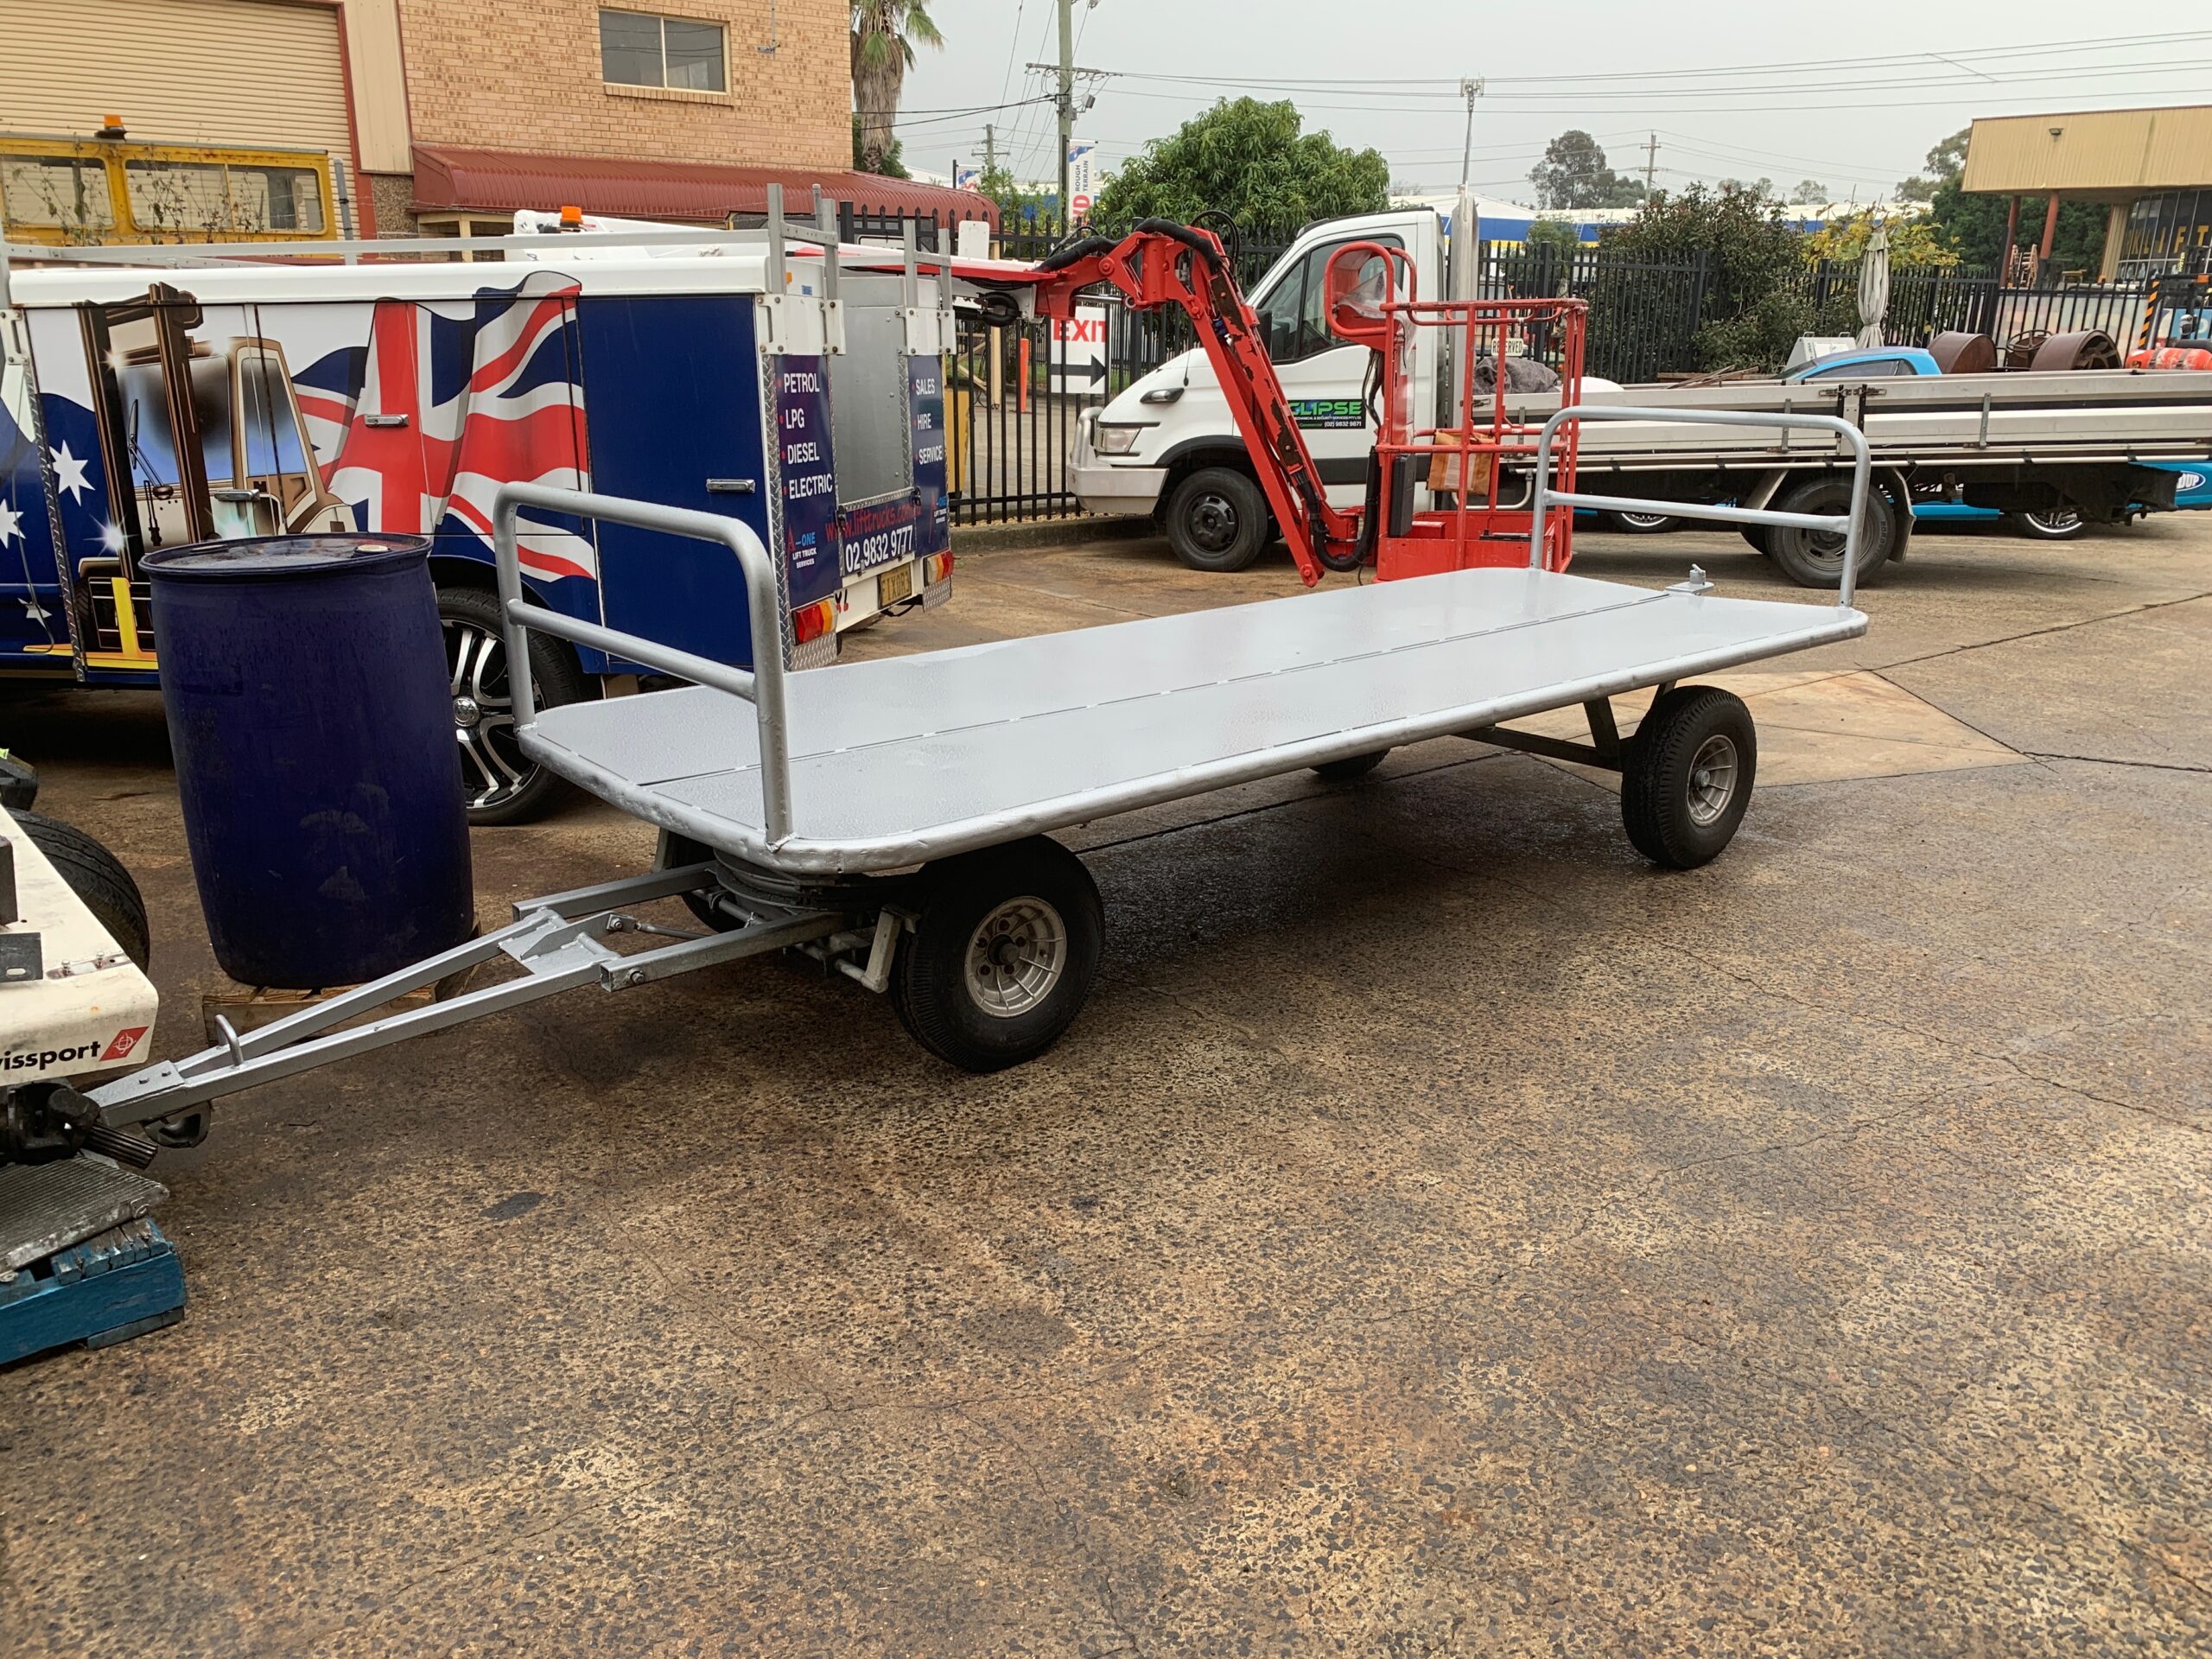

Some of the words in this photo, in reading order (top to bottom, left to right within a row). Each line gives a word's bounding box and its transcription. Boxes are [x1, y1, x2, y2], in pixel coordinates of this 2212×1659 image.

[1053, 319, 1106, 343] EXIT
[1492, 340, 1522, 353] REERVED
[784, 372, 820, 394] PETROL
[916, 378, 936, 396] SALES
[785, 408, 805, 429] LPG
[1288, 401, 1363, 415] CLIPSE
[917, 412, 932, 430] HIRE
[787, 442, 820, 465] DIESEL
[918, 445, 943, 466] SERVICE
[789, 473, 833, 500] ELECTRIC
[792, 550, 802, 561] LIFT
[802, 547, 817, 558] TRUCK
[845, 541, 861, 573] 02
[863, 532, 889, 567] 9832
[891, 524, 913, 557] 9777
[796, 557, 815, 569] SERVICES
[0, 1040, 101, 1071] issport
